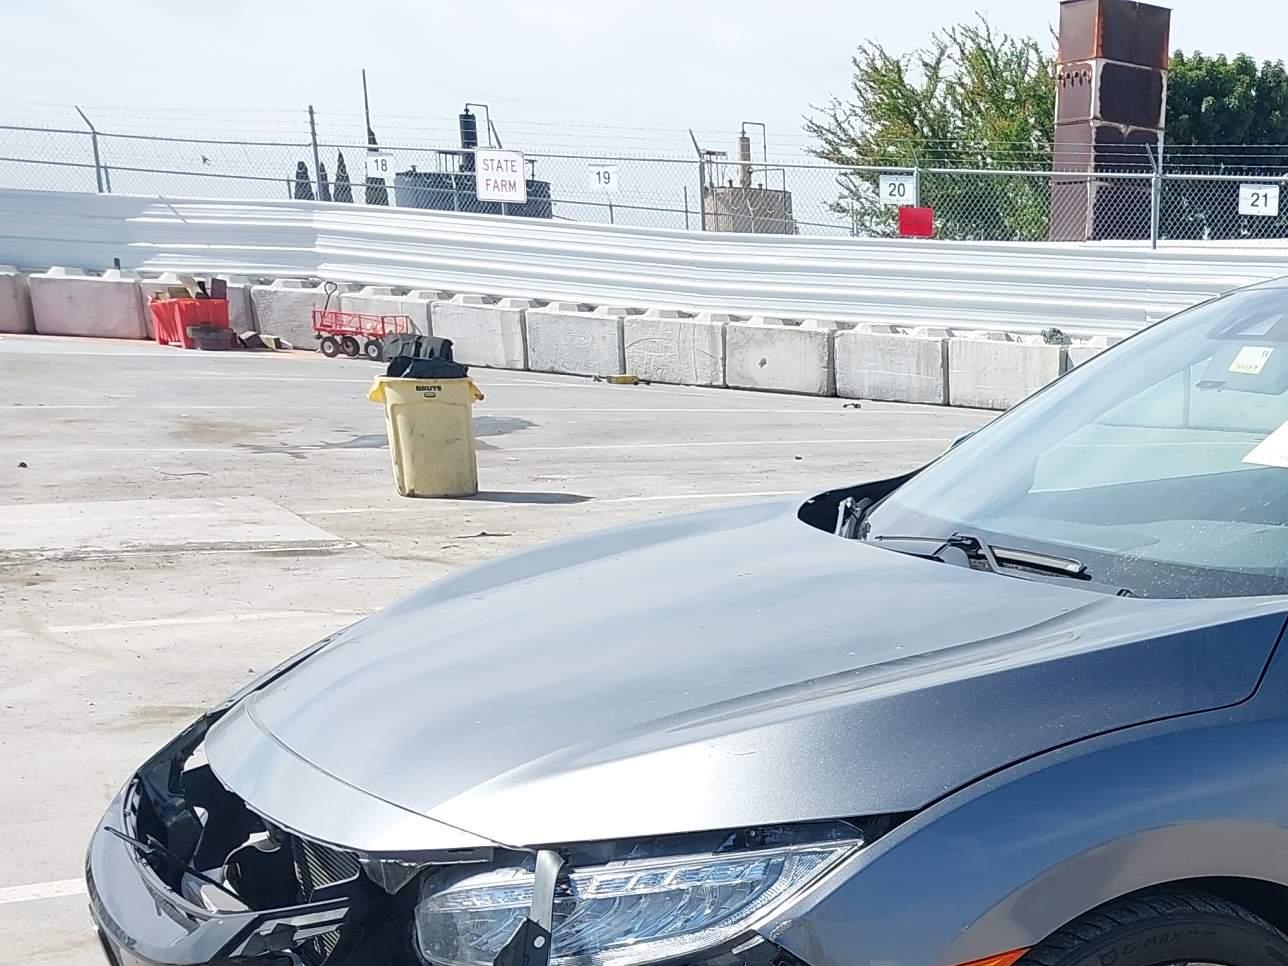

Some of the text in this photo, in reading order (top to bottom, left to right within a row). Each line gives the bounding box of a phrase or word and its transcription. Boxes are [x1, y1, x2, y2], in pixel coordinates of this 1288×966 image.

[375, 158, 388, 172] 18
[482, 158, 518, 174] STATE
[596, 171, 611, 185] 19
[485, 181, 518, 193] FARM
[888, 182, 906, 197] 20
[1250, 192, 1269, 208] 21
